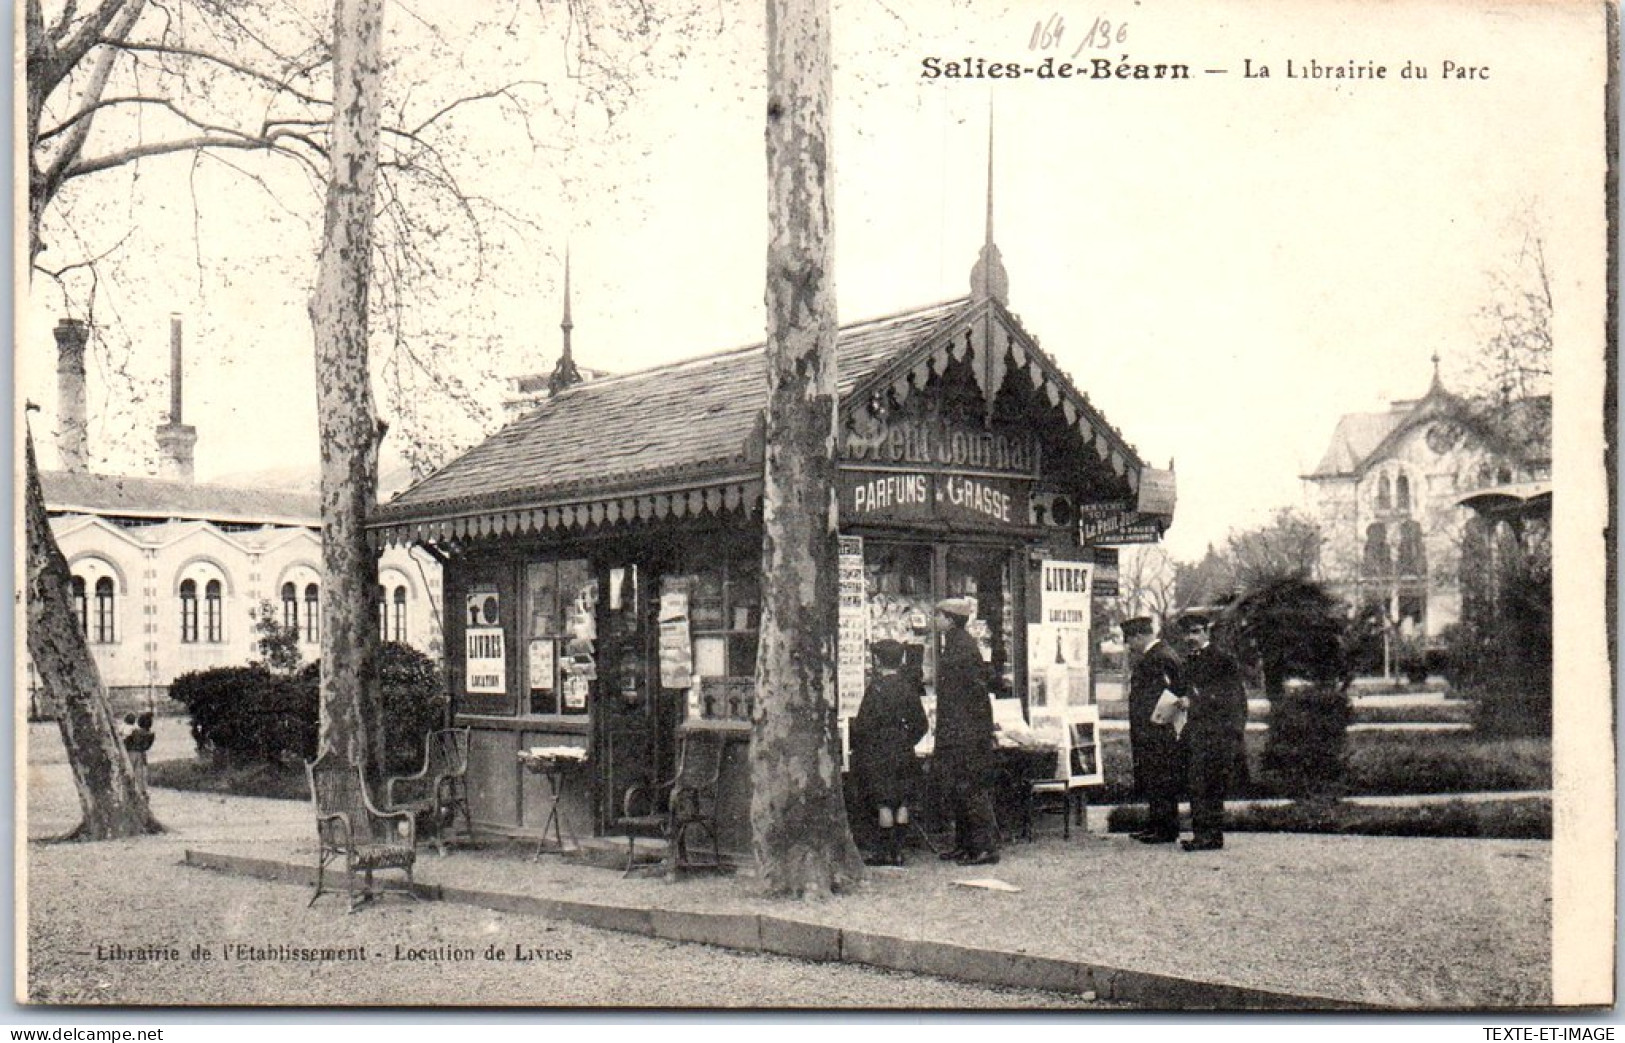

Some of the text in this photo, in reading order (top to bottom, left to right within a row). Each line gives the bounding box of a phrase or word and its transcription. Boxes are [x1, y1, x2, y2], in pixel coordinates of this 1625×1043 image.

[854, 474, 1011, 523] PARFUMS GRASSE
[1045, 566, 1088, 593] LIVRES
[1049, 608, 1083, 623] LOCATION
[469, 634, 502, 659] LIVRES
